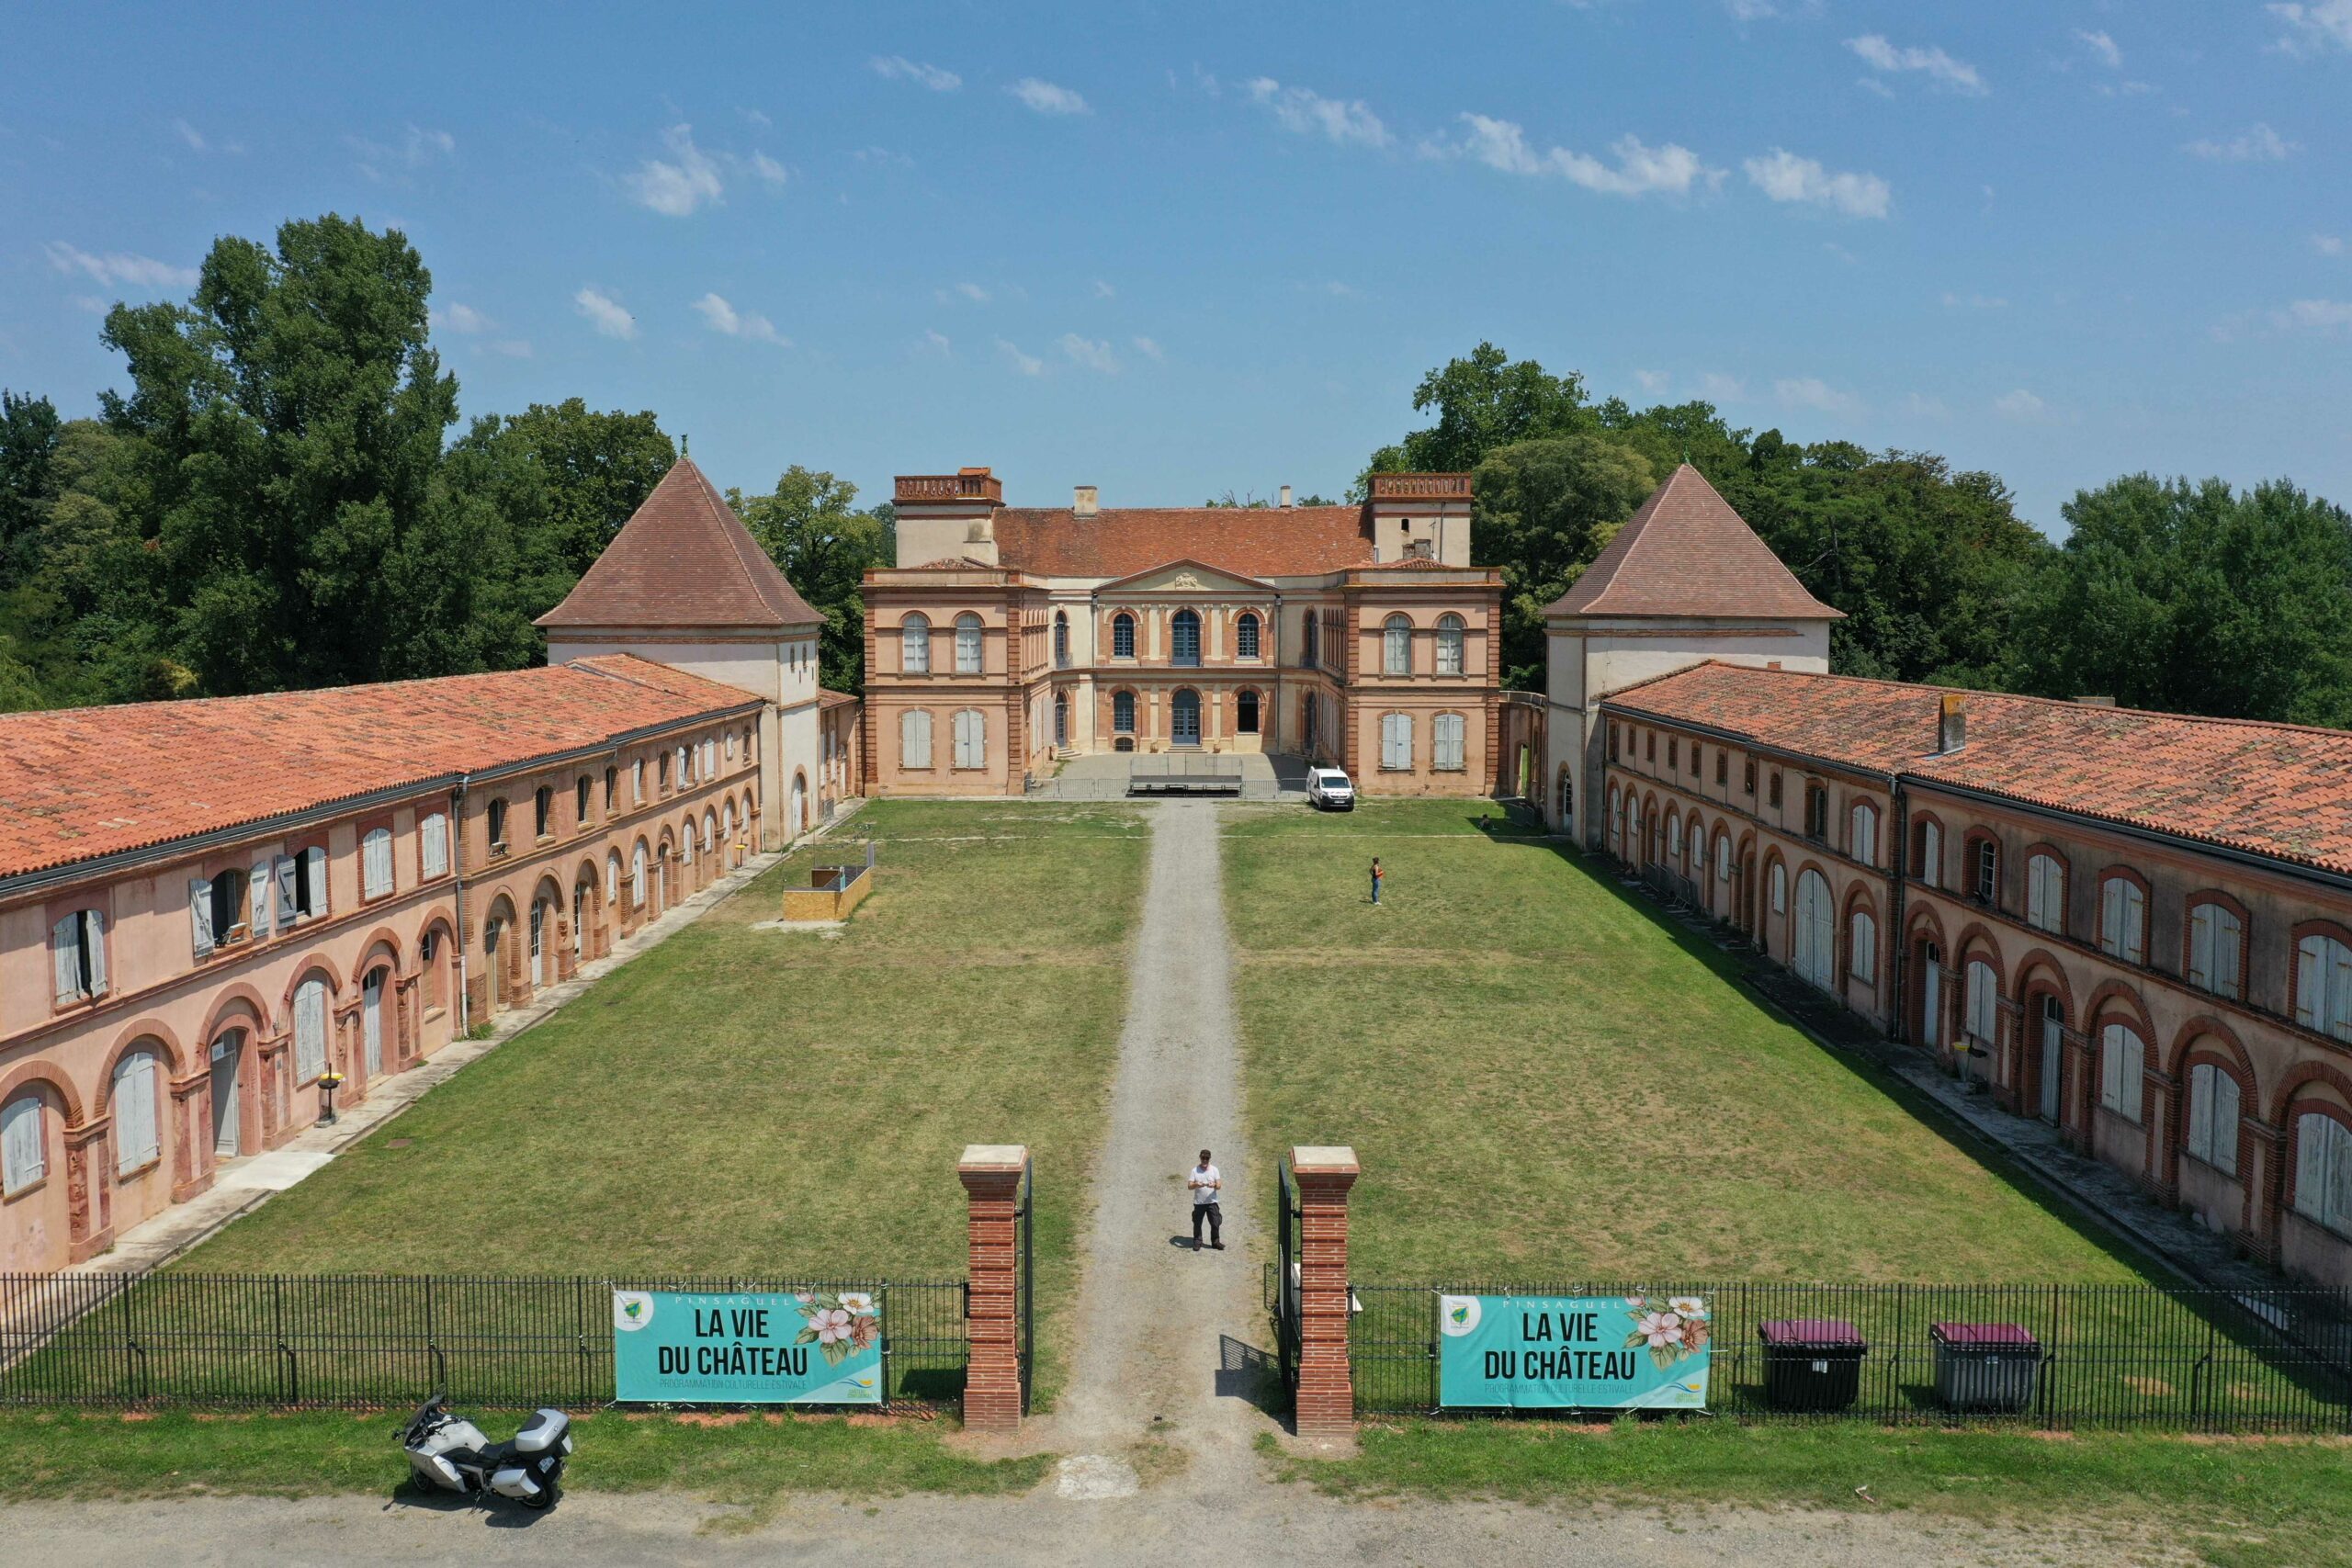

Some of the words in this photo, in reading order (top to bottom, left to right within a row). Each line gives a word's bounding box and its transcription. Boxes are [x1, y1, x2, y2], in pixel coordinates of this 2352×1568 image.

[675, 1296, 790, 1306] PINSAGUEL
[1503, 1301, 1621, 1309] PINSAGUEL
[695, 1309, 725, 1337] LA
[730, 1309, 769, 1338] VIE
[1522, 1313, 1553, 1342] LA
[1559, 1313, 1599, 1342] VIE
[659, 1346, 690, 1375] DU
[697, 1341, 808, 1376] CHÂTEAU
[1485, 1350, 1516, 1380] DU
[1523, 1345, 1636, 1380] CHÂTEAU
[660, 1379, 724, 1389] PROGRAMMATION
[725, 1380, 768, 1390] CULTURELLE
[771, 1380, 807, 1390] ESTIVALE
[1485, 1383, 1549, 1394] PROGRAMMATION
[1550, 1383, 1596, 1394] CULTURELLE
[1598, 1383, 1634, 1394] ESTIVALE
